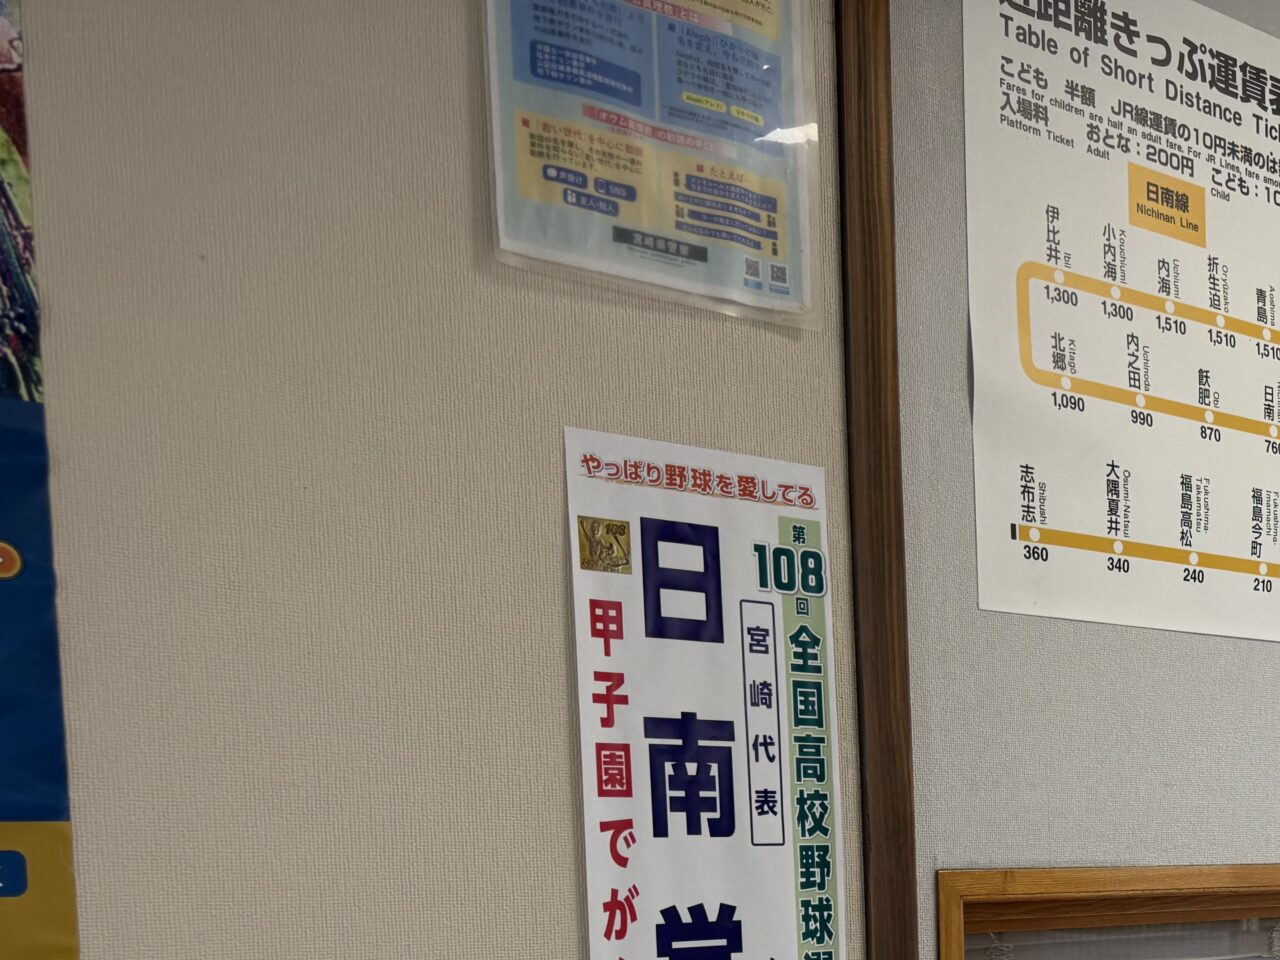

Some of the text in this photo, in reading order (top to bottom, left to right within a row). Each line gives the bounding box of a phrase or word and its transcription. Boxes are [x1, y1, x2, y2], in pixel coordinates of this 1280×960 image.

[1000, 13, 1058, 56] Table
[1070, 46, 1090, 68] of
[1100, 54, 1154, 93] Short
[1165, 78, 1242, 127] Distance
[1000, 55, 1049, 90] こども
[1065, 79, 1096, 109] 半額
[1000, 91, 1050, 127] 入場料
[1000, 78, 1027, 97] Fares
[1031, 88, 1045, 102] for
[1050, 97, 1085, 119] children
[1089, 110, 1103, 124] are
[1107, 117, 1123, 132] half
[1127, 125, 1138, 137] an
[1141, 129, 1162, 146] adult
[1187, 146, 1201, 160] For
[1205, 153, 1217, 165] JR
[1219, 158, 1242, 176] Lines,
[1245, 167, 1260, 181] fare
[1000, 114, 1230, 202] Platform Ticket Adult Child
[1136, 203, 1199, 233] Nichinan Line
[1146, 181, 1190, 215] 日南線
[1046, 203, 1061, 265] 伊比井
[1102, 222, 1118, 282] 小内海
[1119, 229, 1128, 285] Kouchiumi
[1157, 257, 1171, 297] 内海
[1043, 284, 1079, 307] 1,300
[1172, 259, 1180, 299] Uchiumi
[1207, 254, 1222, 311] 折生迫
[1101, 300, 1134, 322] 1,300
[1155, 315, 1187, 336] 1,510
[1256, 287, 1268, 325] 青島
[1050, 331, 1067, 373] 北郷
[1207, 328, 1236, 349] 1,510
[1126, 332, 1141, 391] 内之田
[1142, 345, 1151, 392] Uchinoda
[1051, 391, 1085, 413] 1,090
[1130, 409, 1153, 428] 990
[1263, 385, 1275, 422] 日南
[1200, 426, 1221, 443] 870
[580, 453, 817, 509] やっぱり野球を愛してる
[1019, 463, 1037, 524] 志布志
[1106, 459, 1121, 537] 大隅夏井
[1179, 473, 1193, 548] 福島高松
[1251, 487, 1263, 559] 福島今町
[1023, 544, 1049, 562] 360
[1107, 556, 1130, 573] 340
[1183, 567, 1205, 584] 240
[1253, 578, 1272, 593] 210
[746, 625, 778, 817] 宮崎代表
